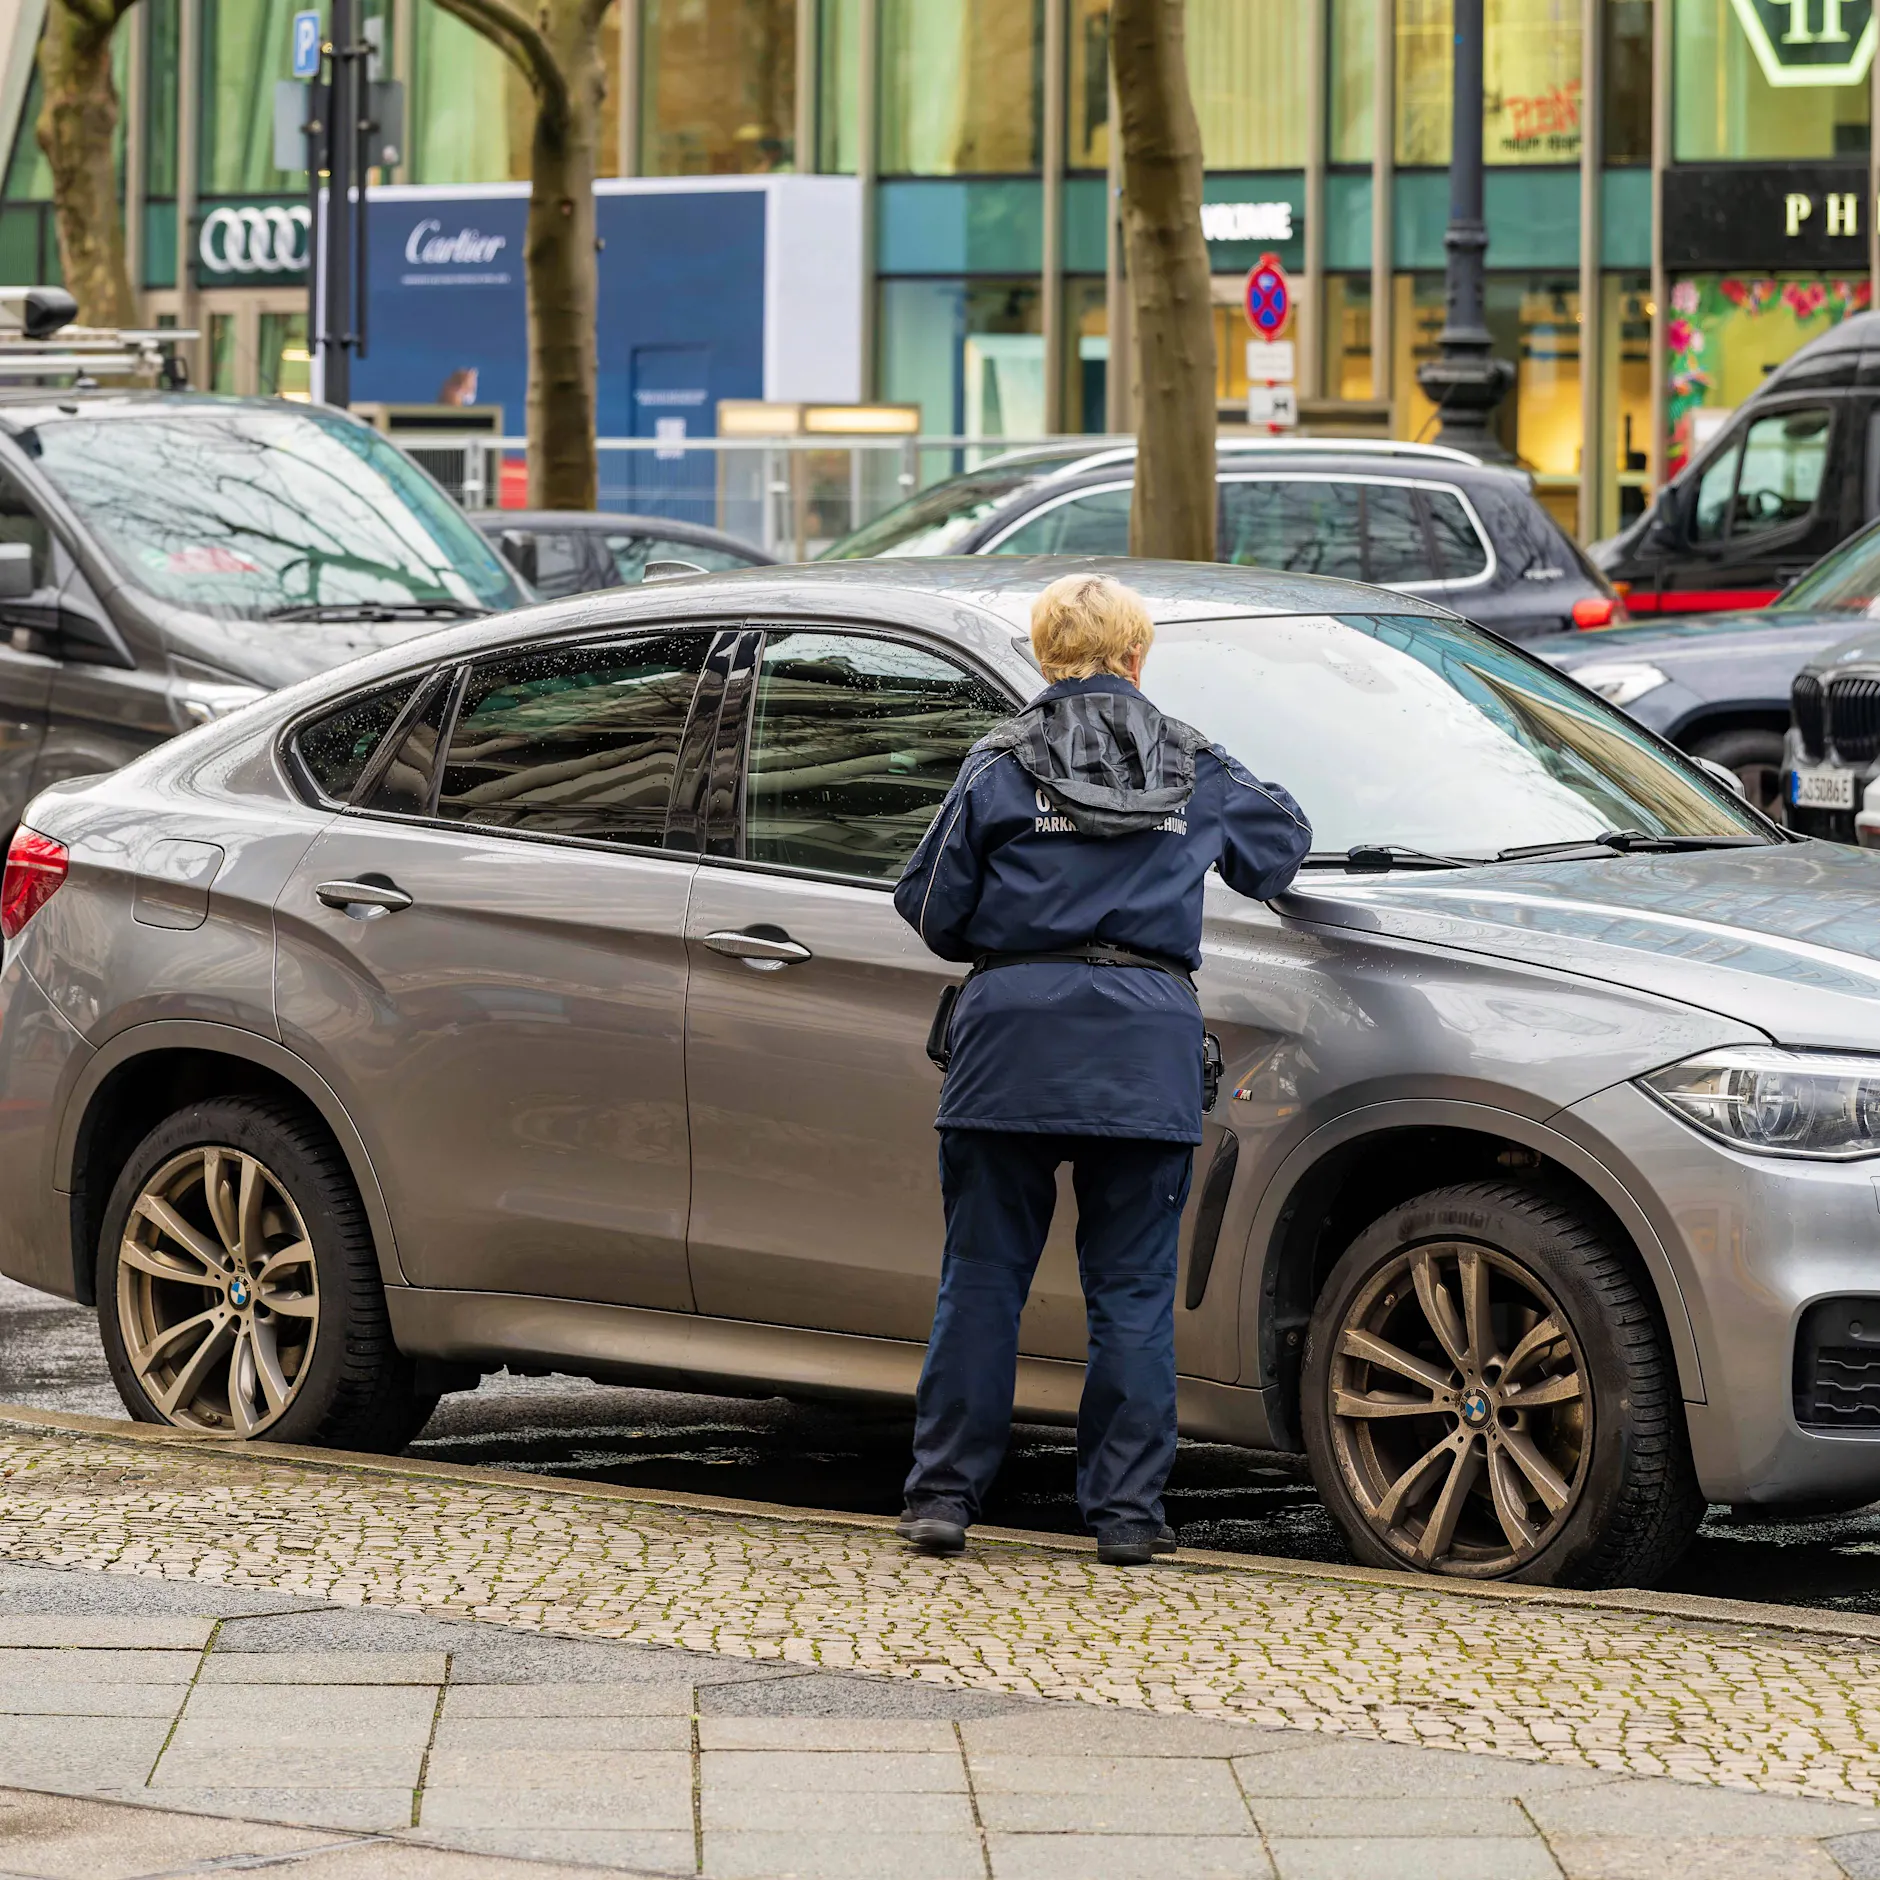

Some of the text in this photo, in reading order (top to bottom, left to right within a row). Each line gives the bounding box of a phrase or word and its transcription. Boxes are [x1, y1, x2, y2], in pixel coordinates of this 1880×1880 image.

[298, 20, 315, 67] P
[1784, 192, 1880, 237] PH
[405, 218, 507, 264] Cartier
